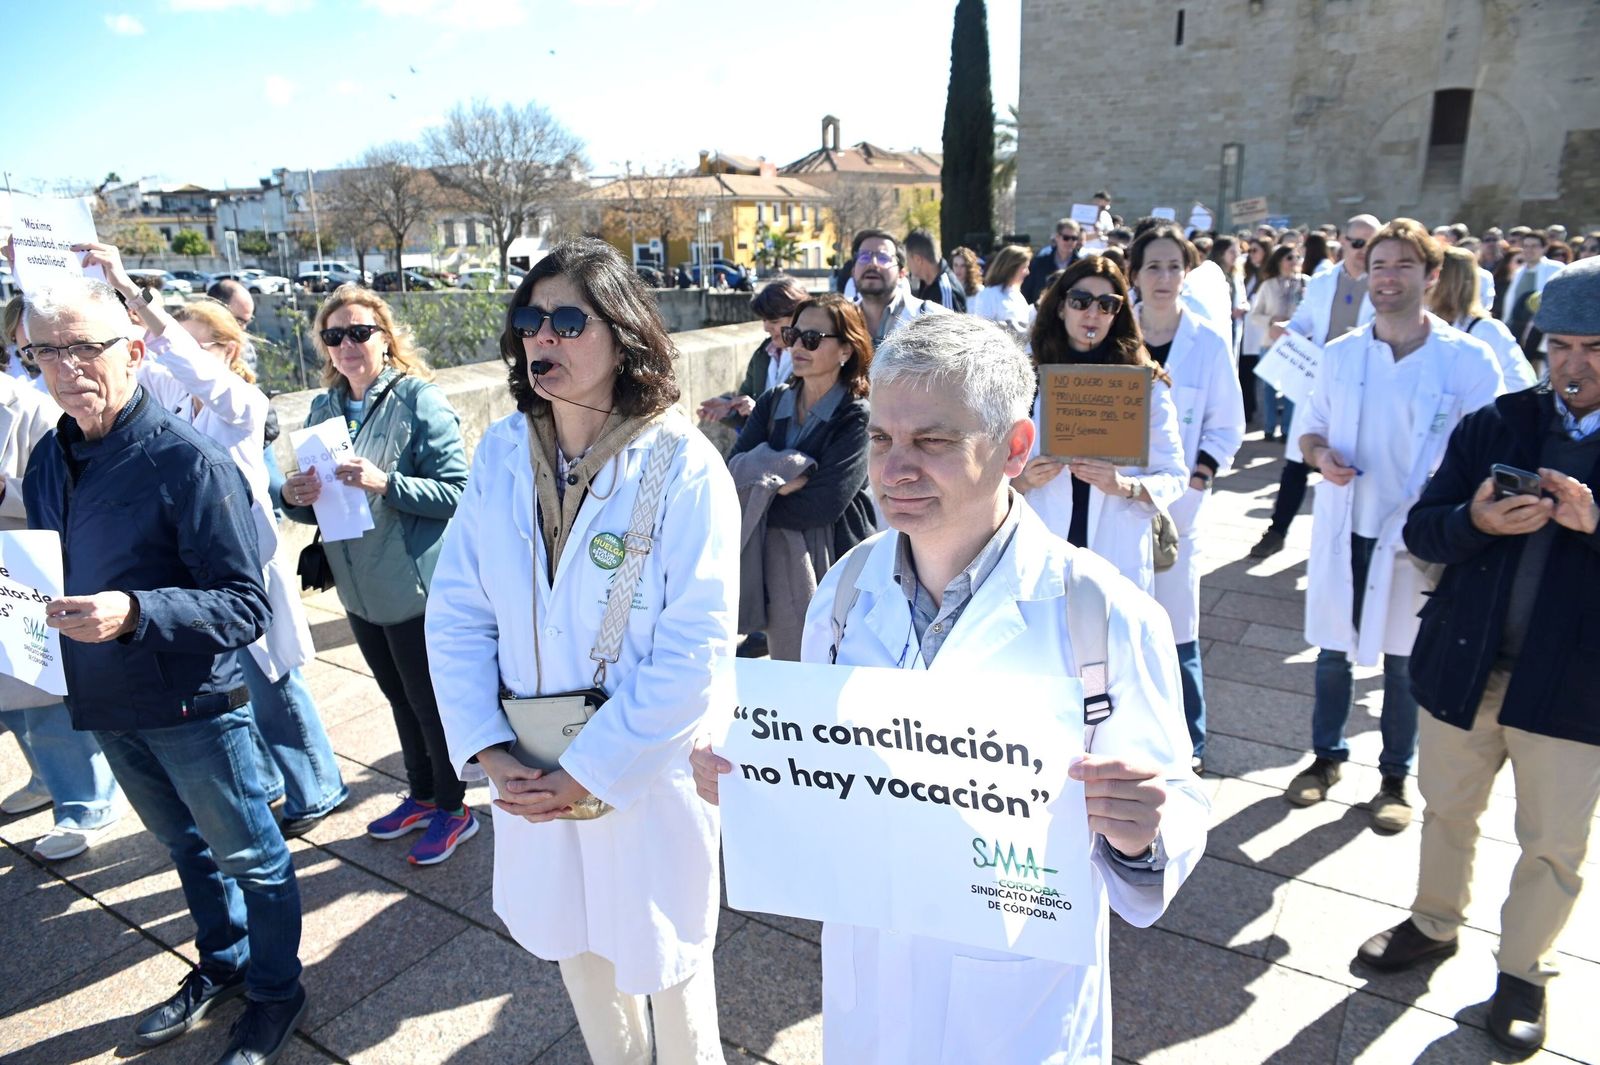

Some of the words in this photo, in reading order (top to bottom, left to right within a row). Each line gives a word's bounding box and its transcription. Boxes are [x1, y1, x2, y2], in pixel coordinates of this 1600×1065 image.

[14, 236, 58, 251] ponsabilidad,
[1053, 376, 1070, 388] NO
[1073, 376, 1103, 387] QUIERO
[1108, 378, 1123, 388] SER
[1123, 396, 1144, 407] QUE
[1123, 411, 1137, 420] DE
[593, 537, 624, 558] HUELGA
[32, 588, 52, 605] de
[733, 705, 804, 742] “Sin
[812, 718, 1043, 775] conciliación,
[740, 760, 781, 785] no
[788, 757, 855, 800] hay
[864, 774, 1050, 819] vocación”
[972, 837, 1058, 880] SMA
[971, 884, 1028, 903] SINDICATO
[1029, 893, 1072, 911] MÉDICO
[988, 900, 1001, 911] DE
[1003, 902, 1057, 921] CÓRDOBA
